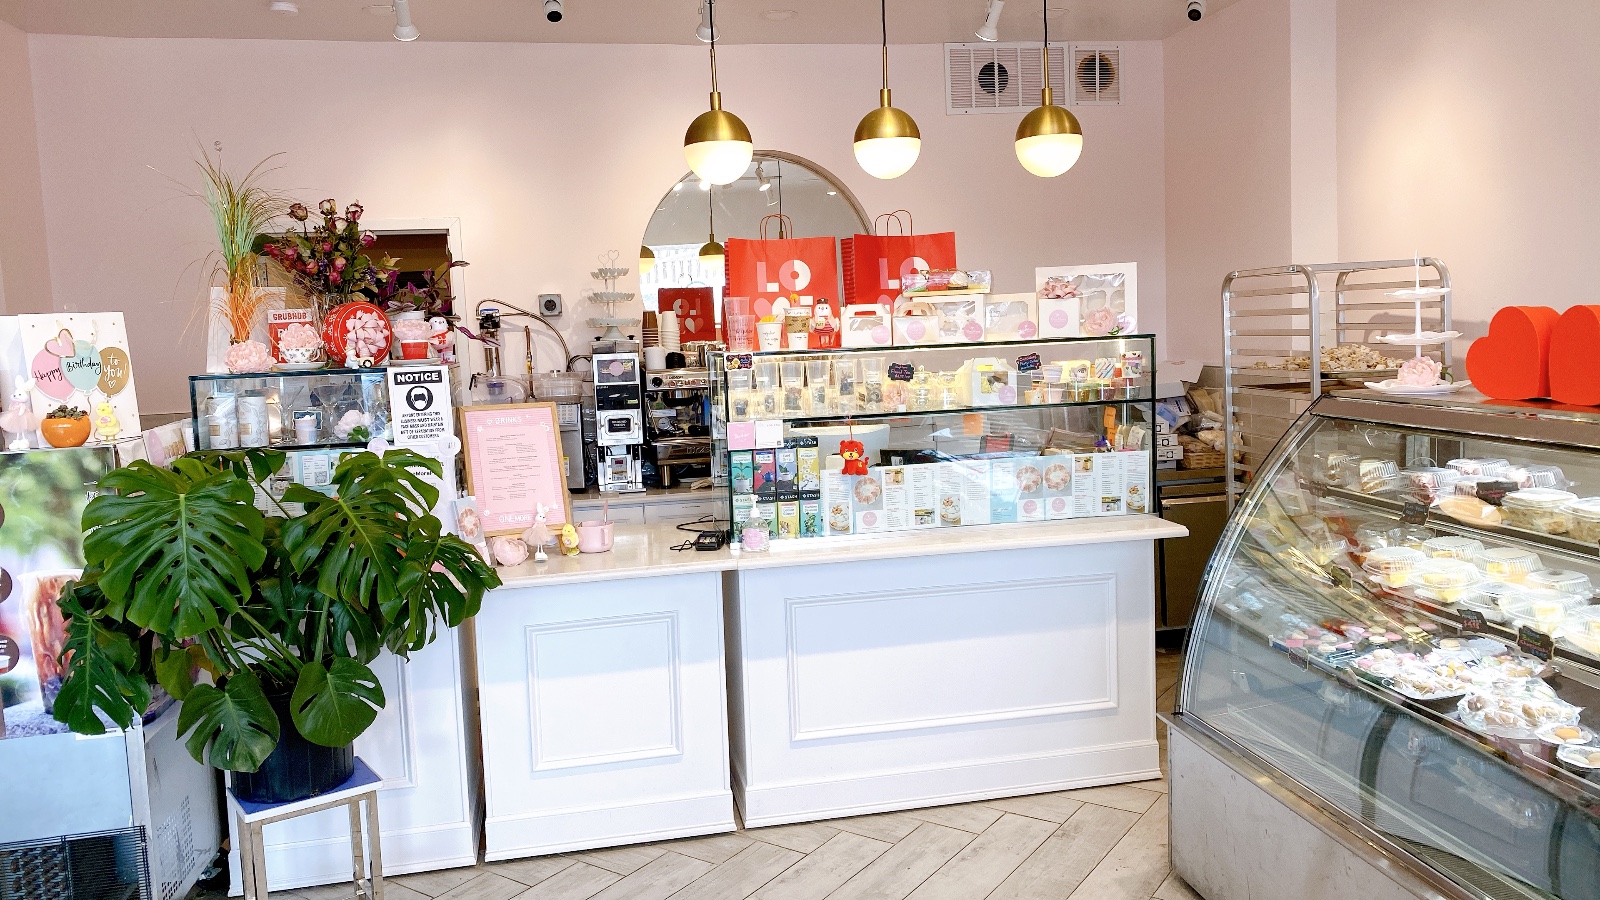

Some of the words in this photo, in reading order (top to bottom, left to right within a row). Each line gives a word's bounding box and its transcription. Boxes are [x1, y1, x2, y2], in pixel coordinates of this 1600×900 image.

[272, 312, 307, 321] GRUBHUB
[107, 353, 121, 366] to
[33, 367, 63, 382] Happy
[65, 357, 102, 375] Birthday
[103, 363, 127, 382] you!
[396, 372, 440, 383] NOTICE
[494, 416, 522, 425] DRINKS
